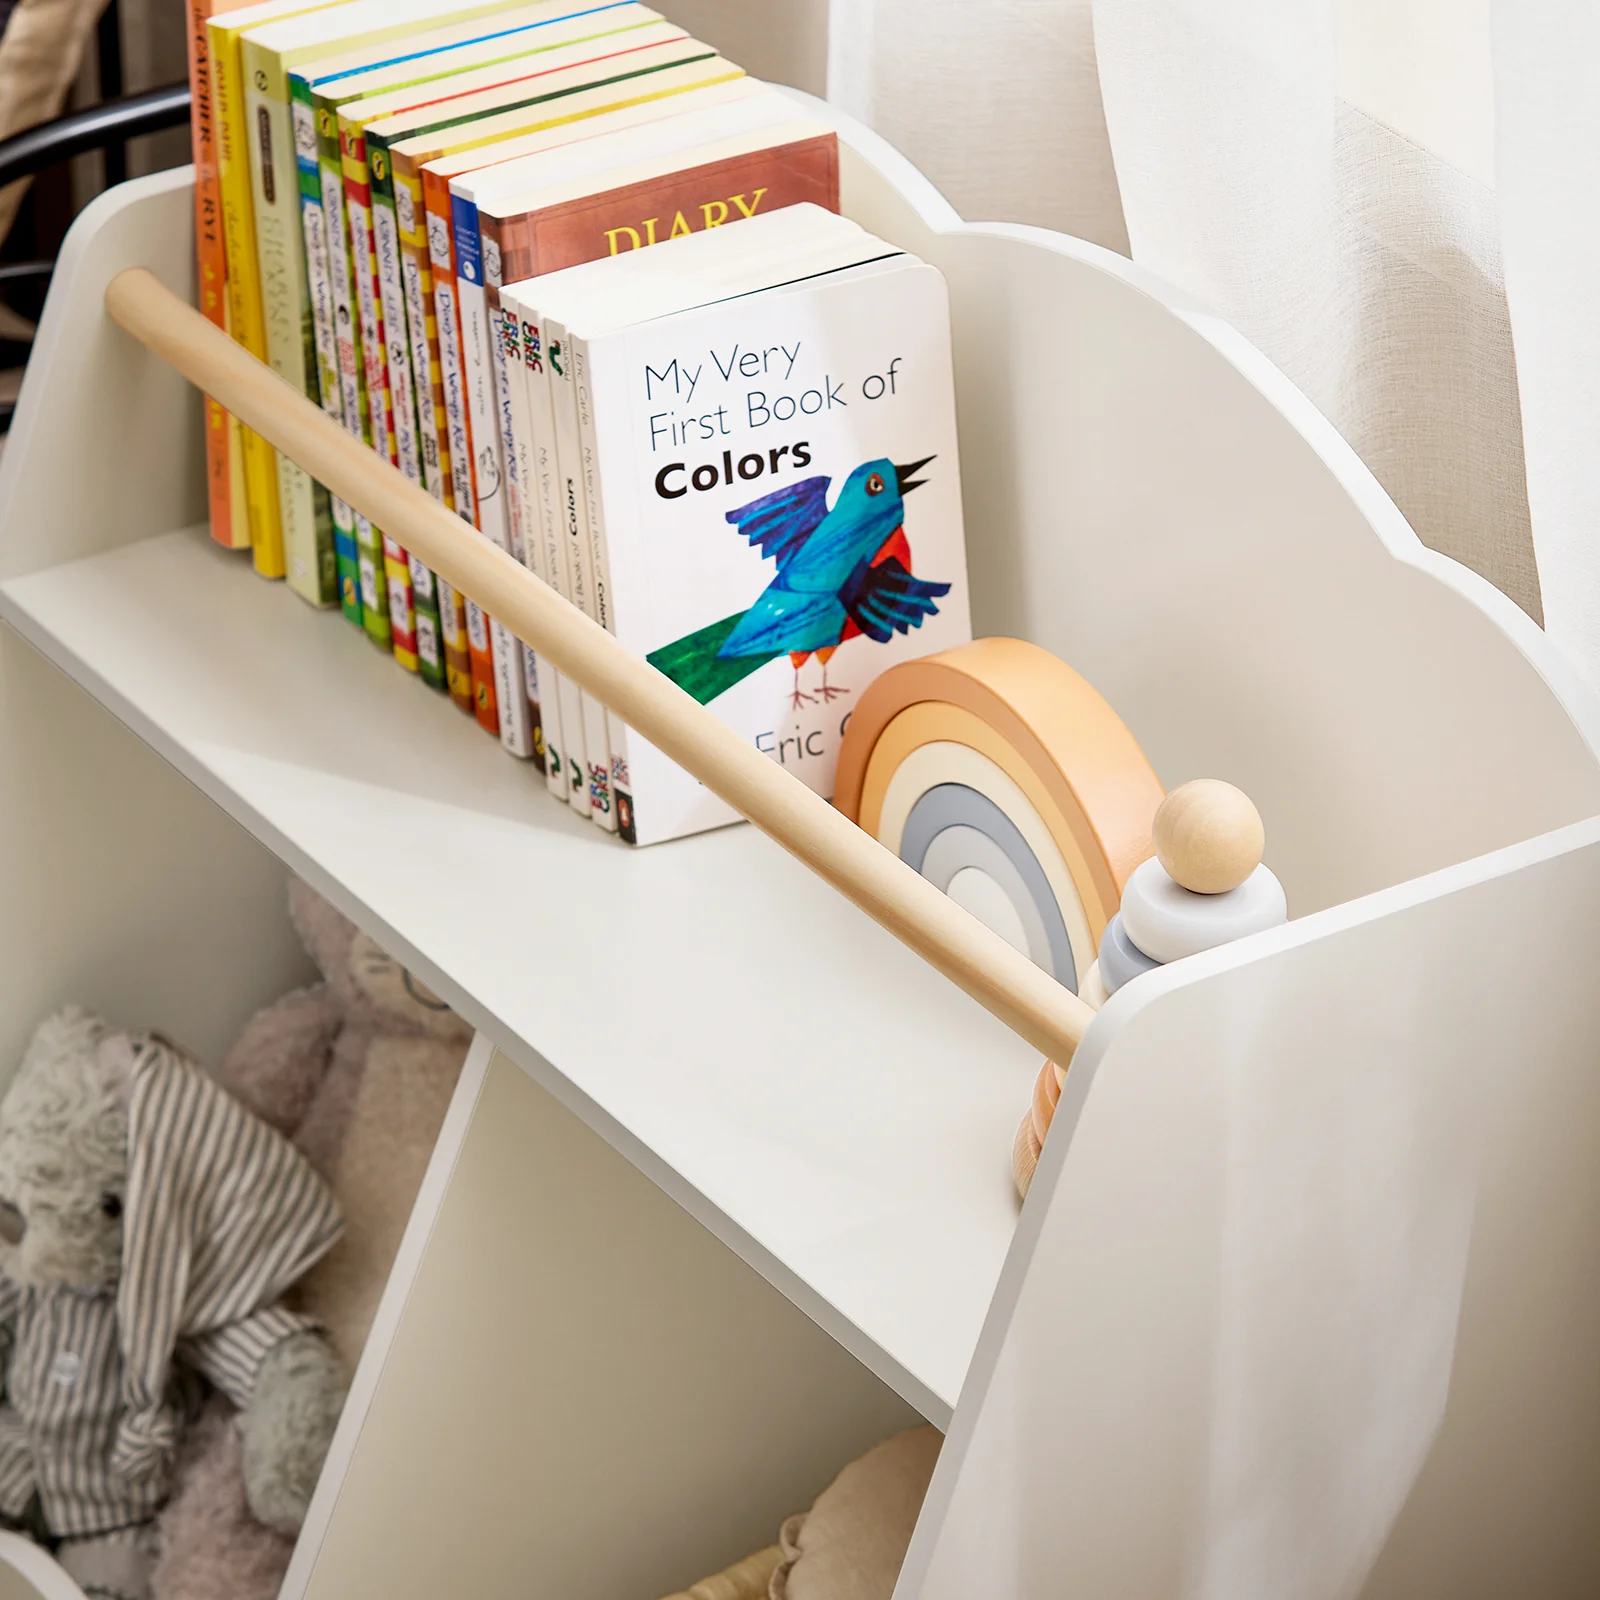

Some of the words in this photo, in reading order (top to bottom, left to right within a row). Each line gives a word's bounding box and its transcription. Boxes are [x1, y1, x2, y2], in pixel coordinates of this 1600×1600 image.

[196, 35, 211, 142] CATCHER
[379, 214, 394, 284] KINNEY
[603, 187, 769, 257] DIARY
[439, 293, 453, 340] Diary
[449, 371, 460, 421] Wimpy
[501, 307, 514, 358] CARLE
[507, 311, 521, 361] ERIC
[521, 320, 536, 372] CARLE
[528, 323, 543, 375] ERIC
[416, 342, 428, 394] Wimpy
[493, 317, 507, 367] Diary
[502, 400, 514, 452] Wimpy
[560, 339, 572, 383] Philomel
[574, 352, 585, 380] Eric
[645, 358, 703, 404] My
[709, 341, 801, 382] Very
[578, 385, 591, 427] Carle
[649, 405, 732, 452] First
[746, 374, 848, 429] Book
[862, 357, 902, 400] of
[654, 441, 812, 500] Colors
[565, 477, 579, 537] Colors
[755, 724, 825, 764] Eric
